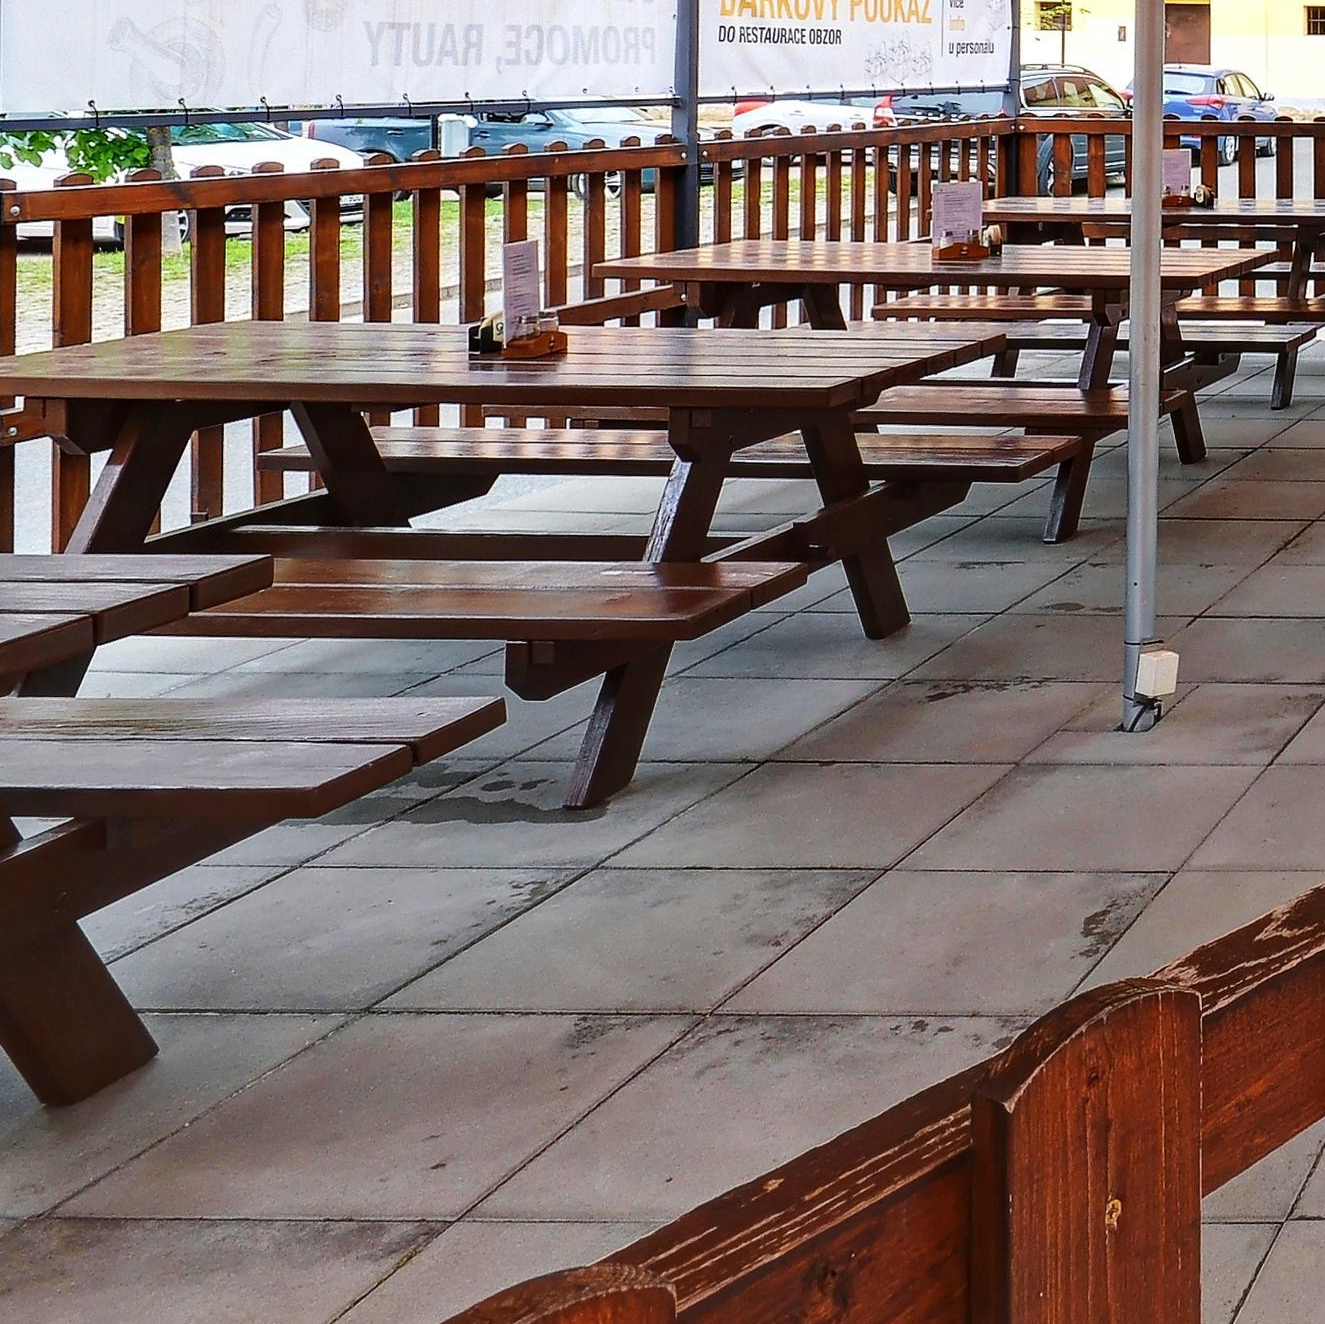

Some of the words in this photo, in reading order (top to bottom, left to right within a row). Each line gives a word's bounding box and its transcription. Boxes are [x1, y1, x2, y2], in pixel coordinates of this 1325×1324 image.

[718, 25, 736, 44] DO
[738, 26, 807, 45] RESTAURACE
[808, 28, 842, 45] OBZOR
